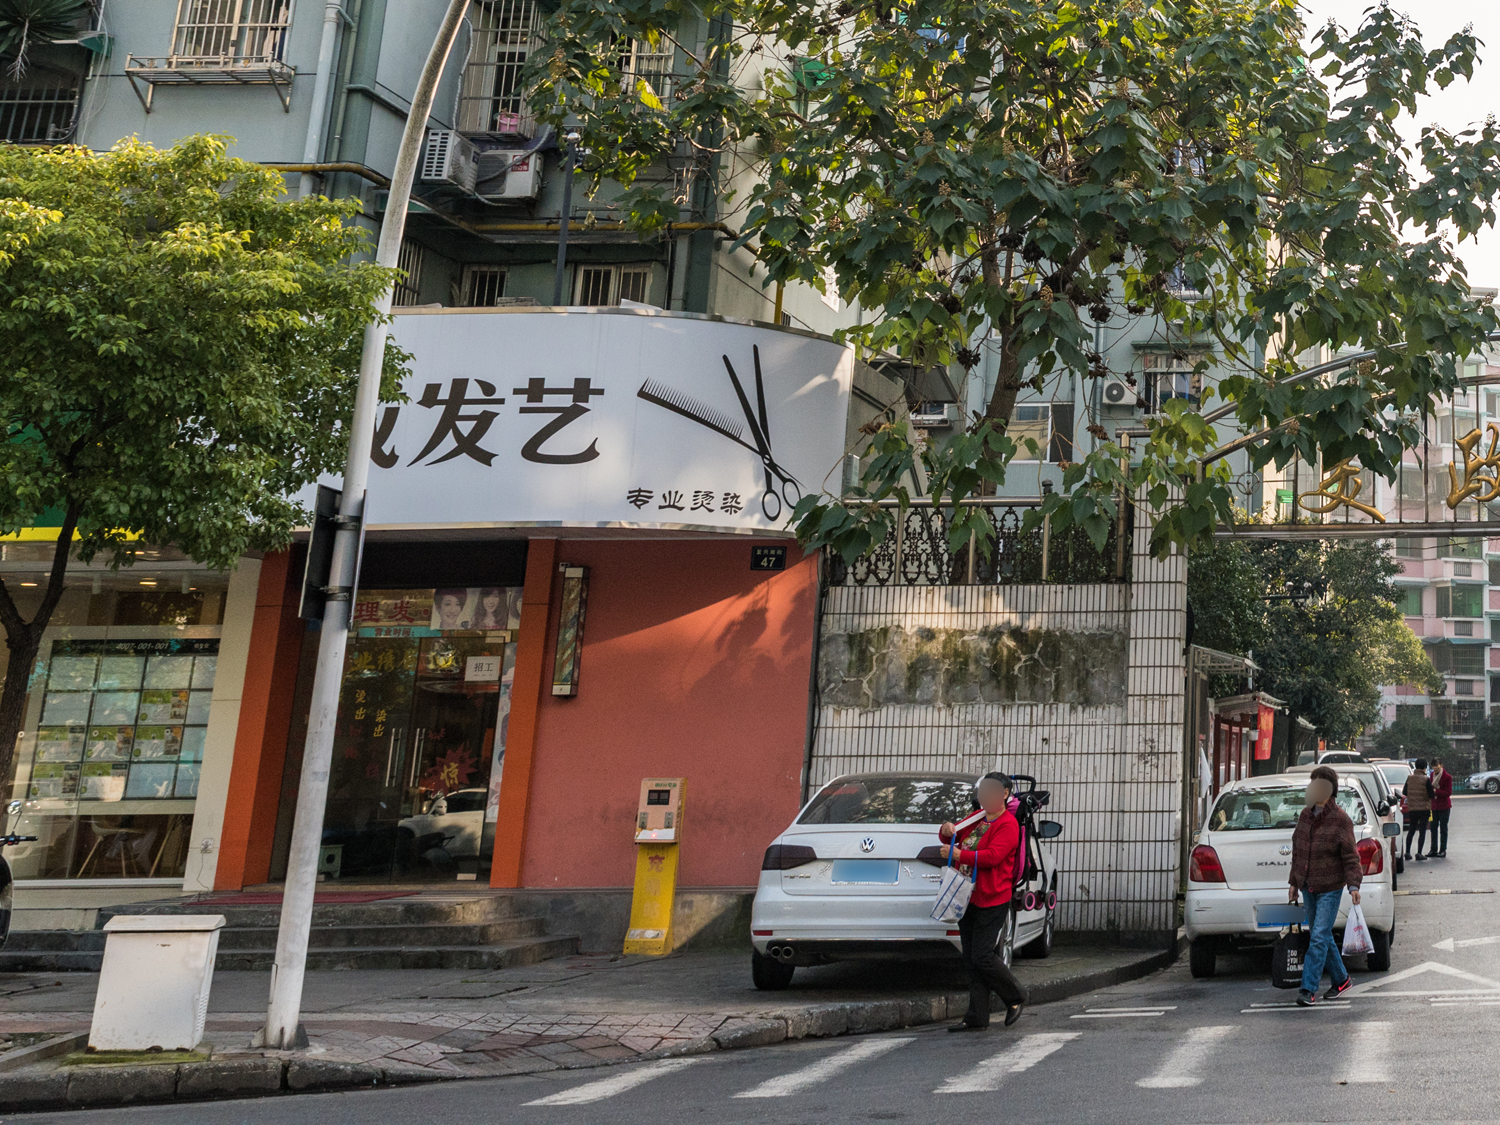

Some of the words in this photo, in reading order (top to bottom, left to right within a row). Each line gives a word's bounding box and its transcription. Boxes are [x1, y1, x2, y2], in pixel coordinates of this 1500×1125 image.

[626, 487, 744, 515] 专业烫染
[760, 557, 776, 567] 47
[474, 662, 494, 672] 招工
